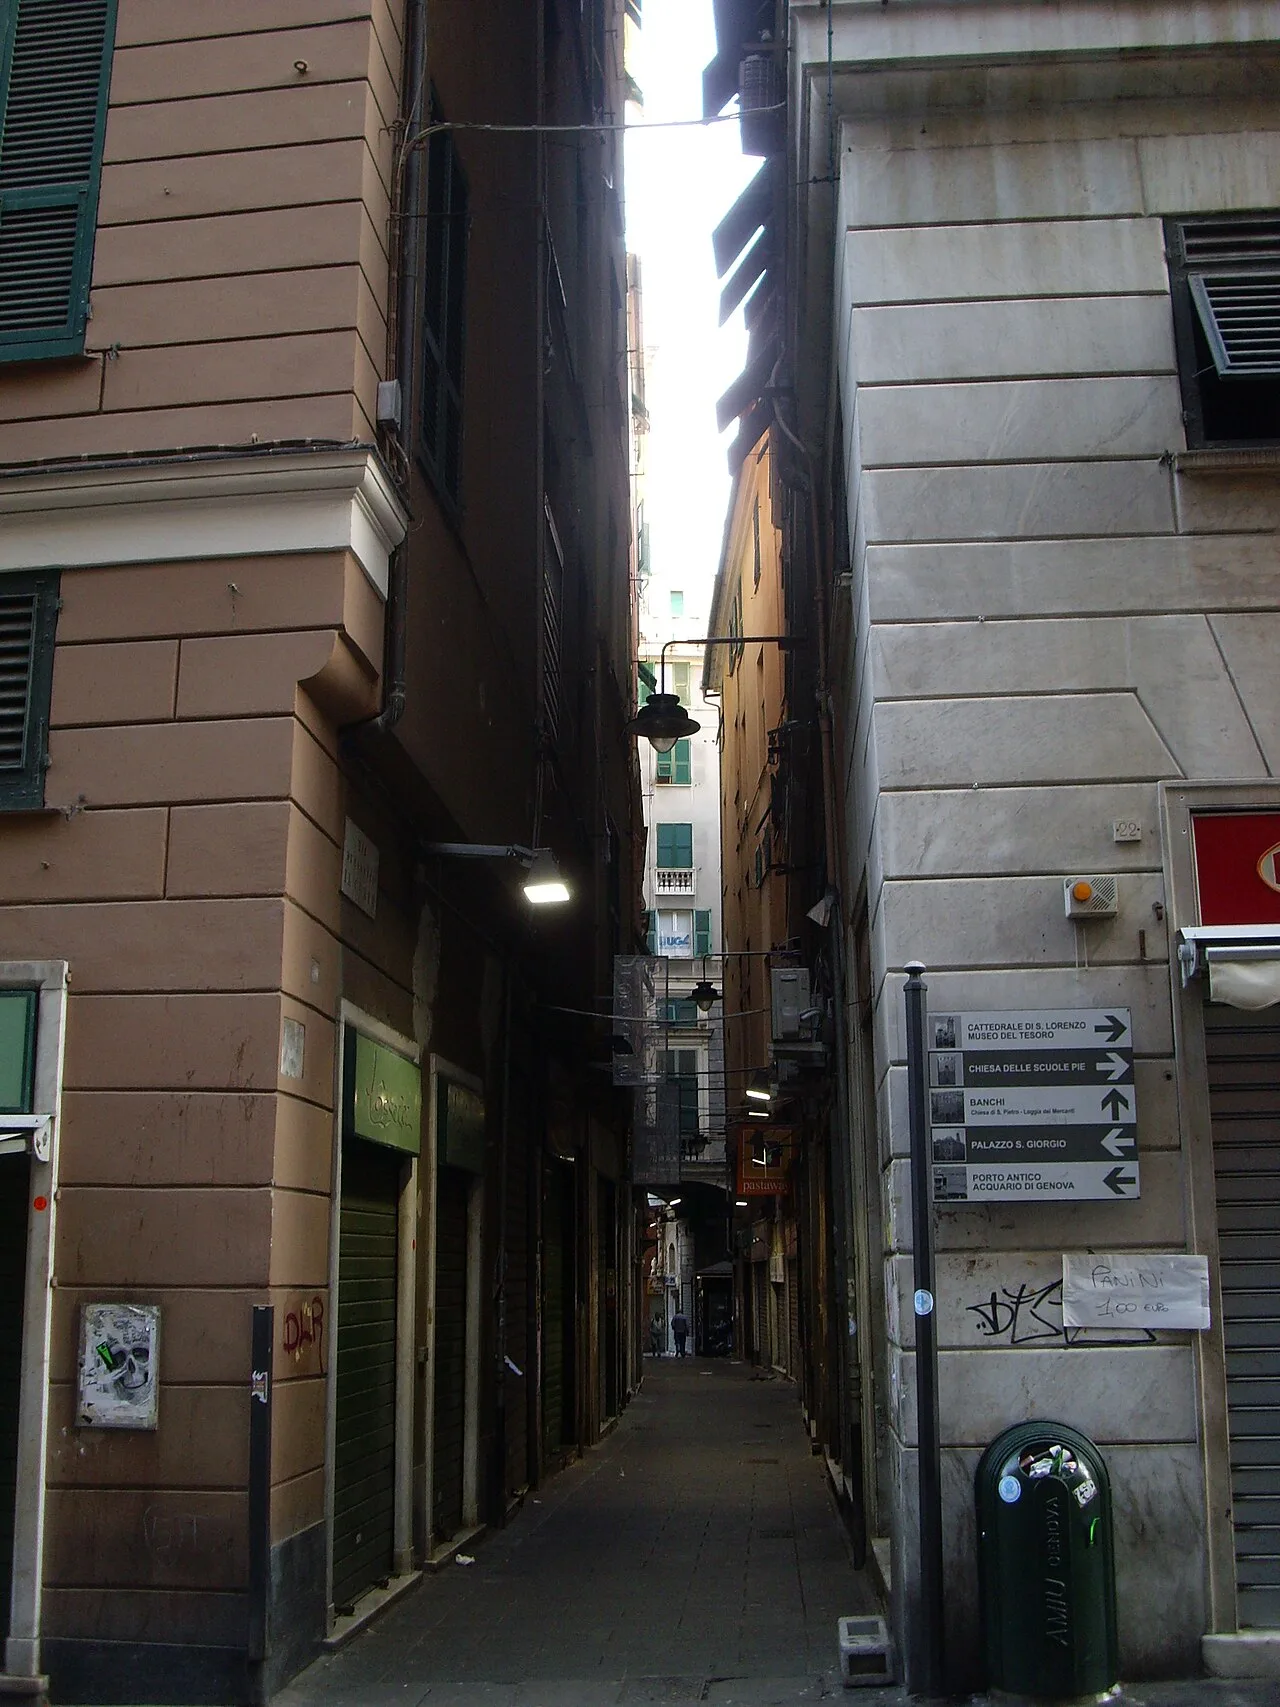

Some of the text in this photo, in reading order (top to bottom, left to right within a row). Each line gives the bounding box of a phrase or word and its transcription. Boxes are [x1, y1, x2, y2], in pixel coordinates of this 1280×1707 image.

[1117, 822, 1136, 836] 22
[967, 1021, 1087, 1032] CATTEDRALE DI S. LORENZO
[968, 1031, 1055, 1041] MUSEO DEL TESORO
[968, 1062, 1086, 1073] CHIESA DELLE SCUOLE PIE
[969, 1098, 1005, 1107] BANCHI
[1023, 1108, 1042, 1116] Loggia
[971, 1139, 1067, 1149] PALAZZO S. GIORGIO
[972, 1173, 1042, 1182] PORTO ANTICO
[972, 1181, 1075, 1191] ACQUARIO DI GENOVA
[1045, 1496, 1068, 1647] AMIU GENOVA
